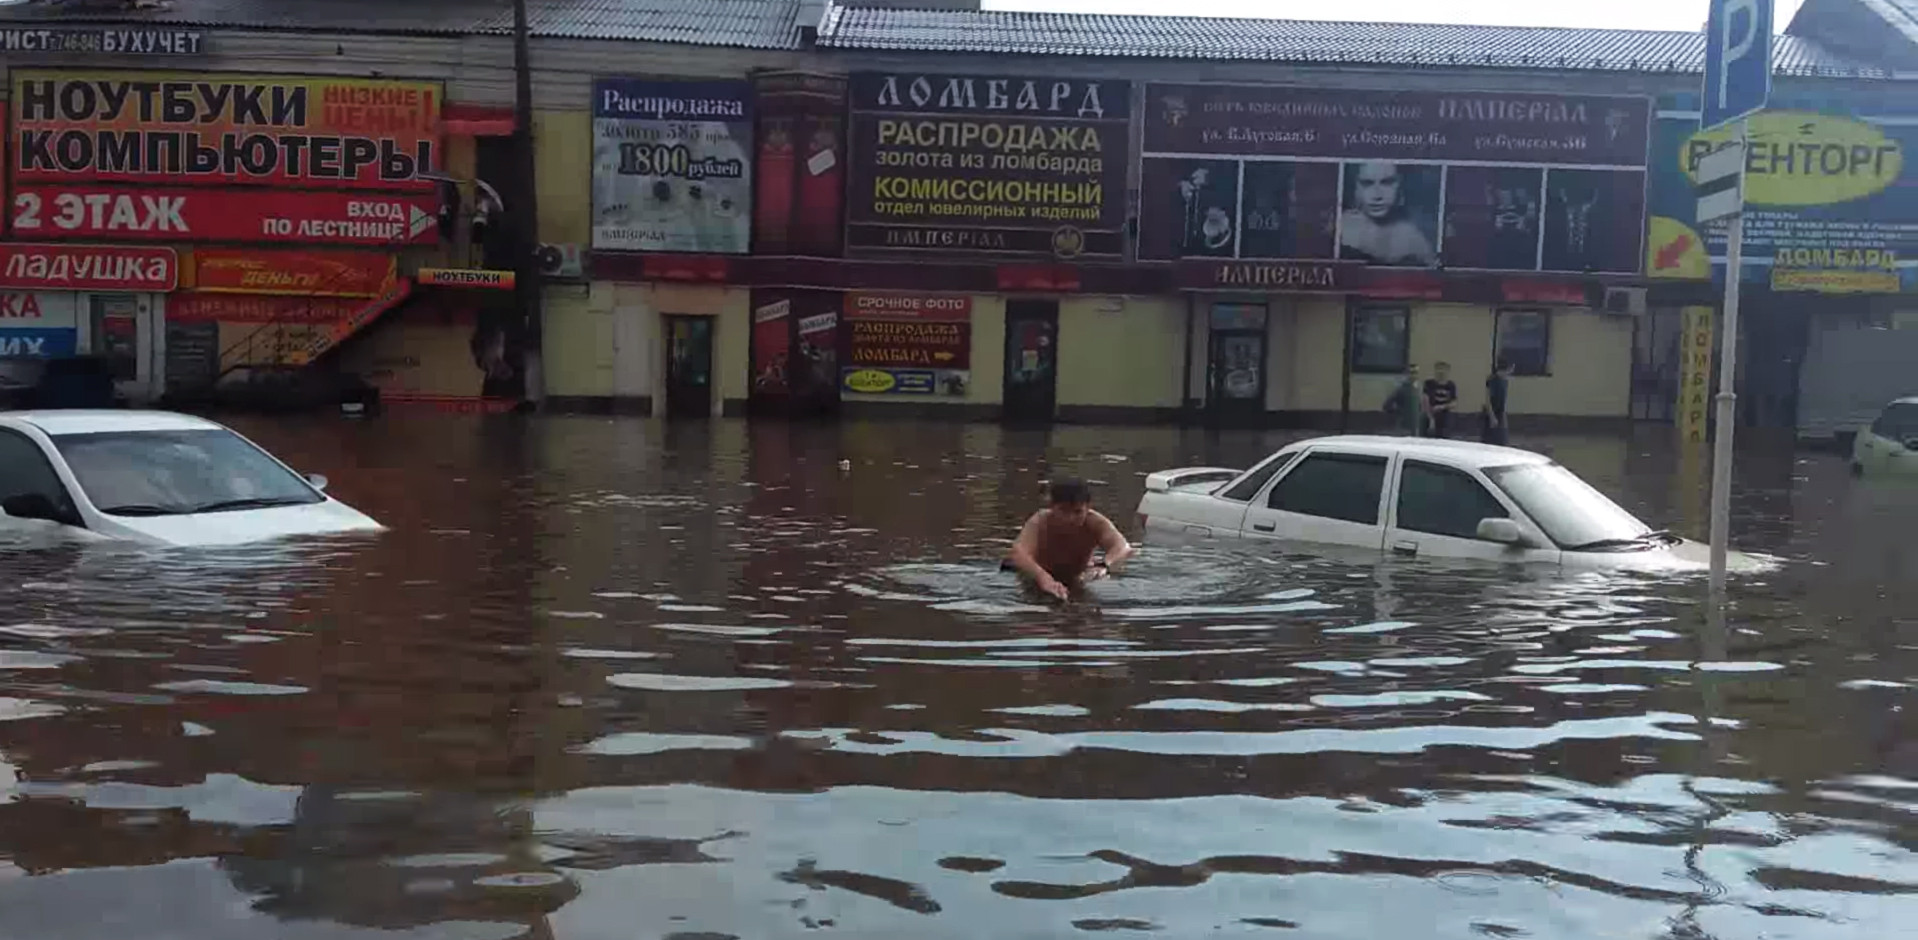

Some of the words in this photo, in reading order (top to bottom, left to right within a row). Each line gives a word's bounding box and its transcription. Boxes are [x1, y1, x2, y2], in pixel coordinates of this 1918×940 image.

[103, 31, 200, 52] БУХУЧЕТ
[21, 80, 307, 128] НОУТБУКИ
[323, 85, 417, 106] НИЗКИЕ
[603, 90, 743, 118] Распродажа
[878, 76, 1104, 117] ЛОМБАРД
[878, 120, 1101, 152] РАСПРОДАЖА
[18, 128, 435, 181] КОМПЬЮТЕРЫ
[620, 144, 688, 176] 1800
[688, 158, 740, 178] рублей
[876, 150, 953, 168] золота
[960, 153, 984, 168] из
[990, 153, 1102, 175] ломбарда
[1687, 140, 1897, 177] ВЕНТОРГ
[875, 176, 1102, 204] КОМИССИОННЫЙ
[14, 195, 42, 229] 2
[53, 194, 190, 233] ЭТАЖ
[348, 201, 404, 221] ВХОД
[875, 202, 924, 216] отдел
[930, 203, 1026, 219] ювелирных
[1031, 205, 1101, 220] изделий
[263, 217, 292, 236] ПО
[298, 218, 405, 240] ЛЕСТНИЦЕ
[1774, 247, 1896, 271] ЛОМБАРД
[433, 270, 501, 285] НОУТБУКИ
[857, 296, 920, 310] СРОЧНОЕ
[924, 298, 965, 311] ФОТО
